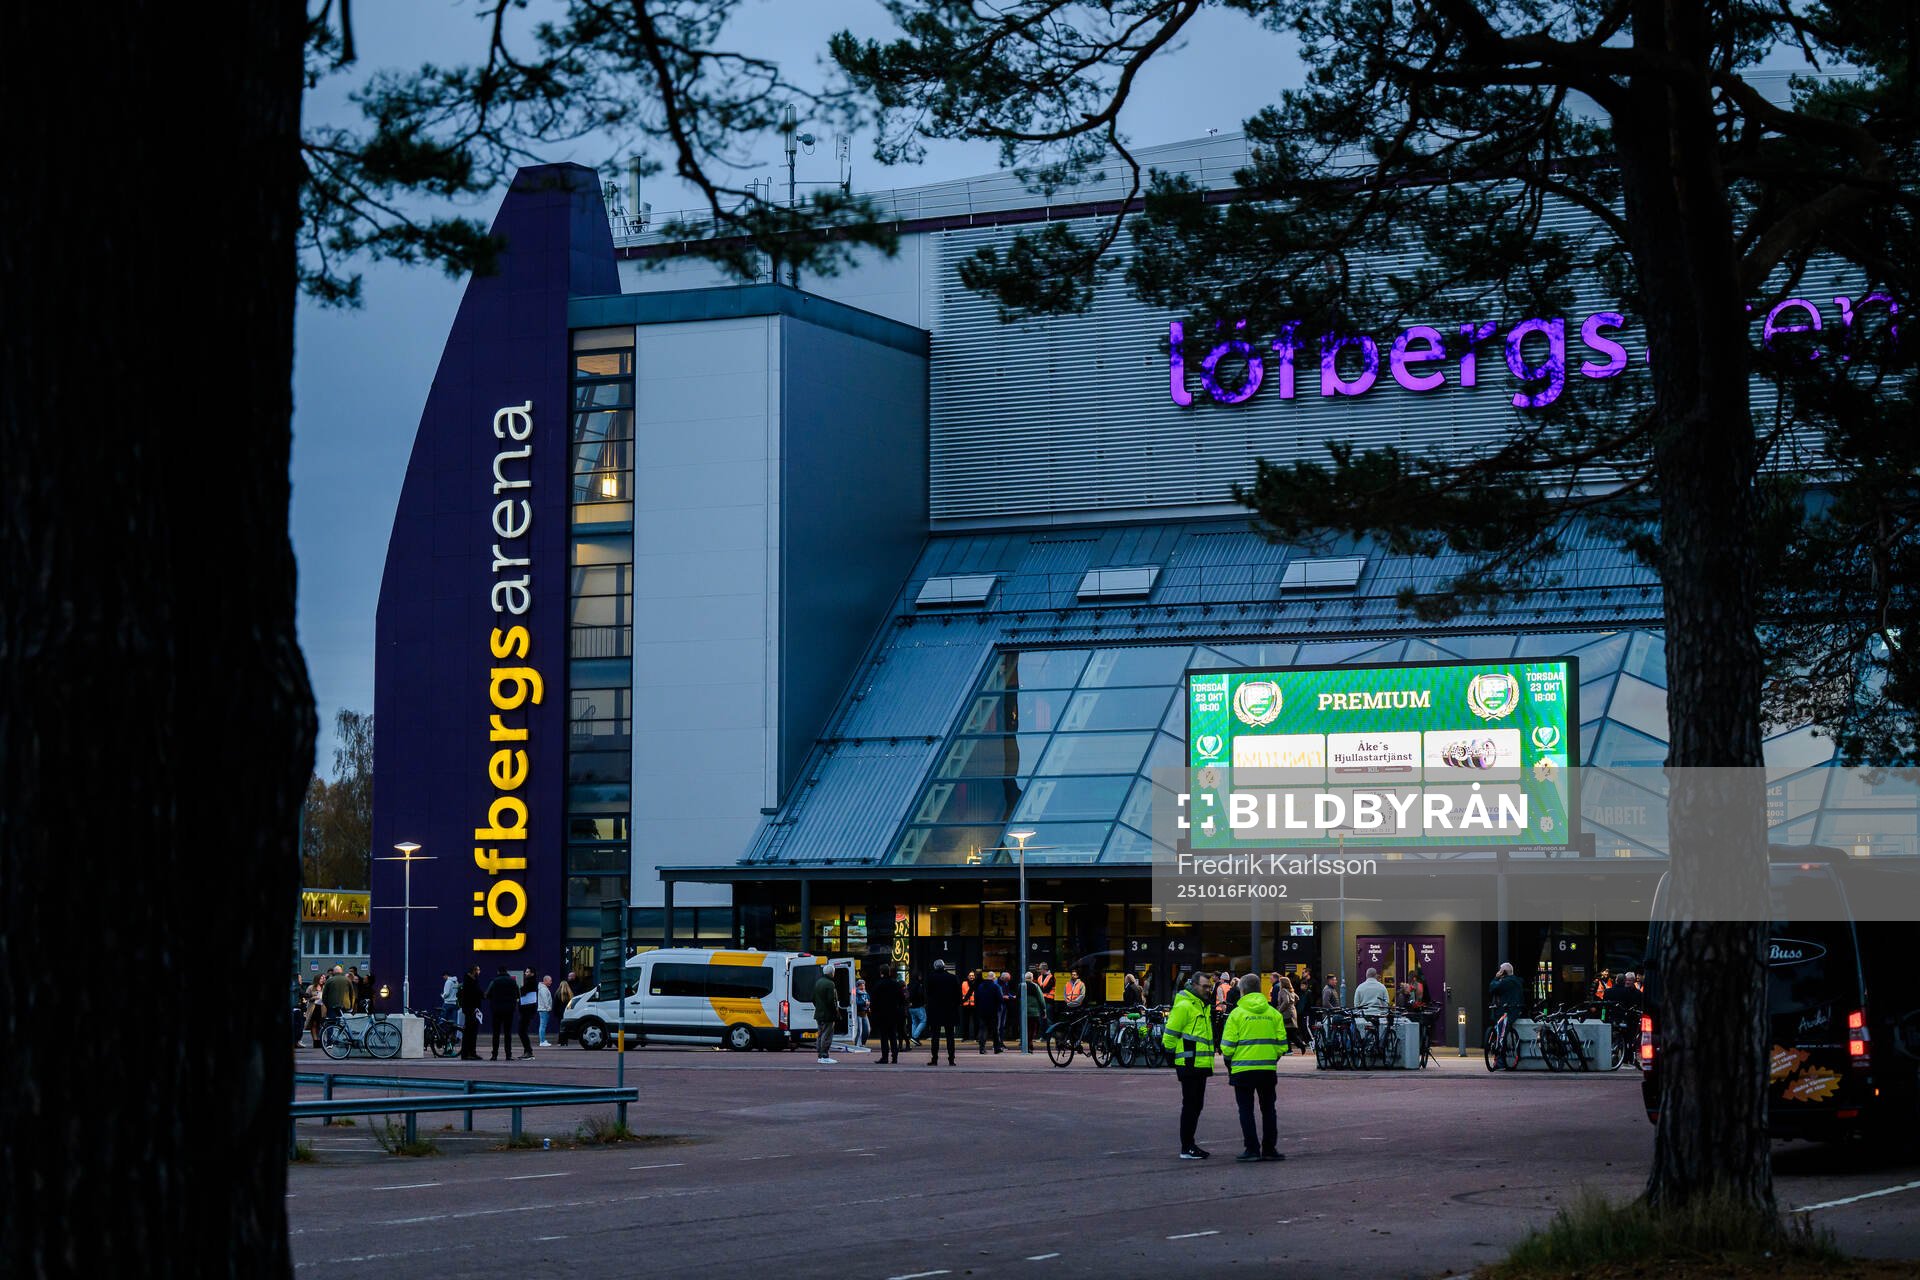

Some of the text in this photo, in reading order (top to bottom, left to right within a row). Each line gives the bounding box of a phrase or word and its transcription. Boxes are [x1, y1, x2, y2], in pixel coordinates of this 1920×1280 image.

[1530, 682, 1541, 692] 23
[1195, 693, 1206, 702] 23
[1317, 689, 1431, 711] PREMIUM
[1334, 752, 1413, 764] Hjullastartjänst
[1595, 806, 1646, 825] ARBETE
[1131, 941, 1138, 951] 3
[1167, 941, 1175, 951] 4
[1281, 941, 1288, 951] 5
[1559, 940, 1567, 951] 6
[1768, 944, 1802, 959] Buss
